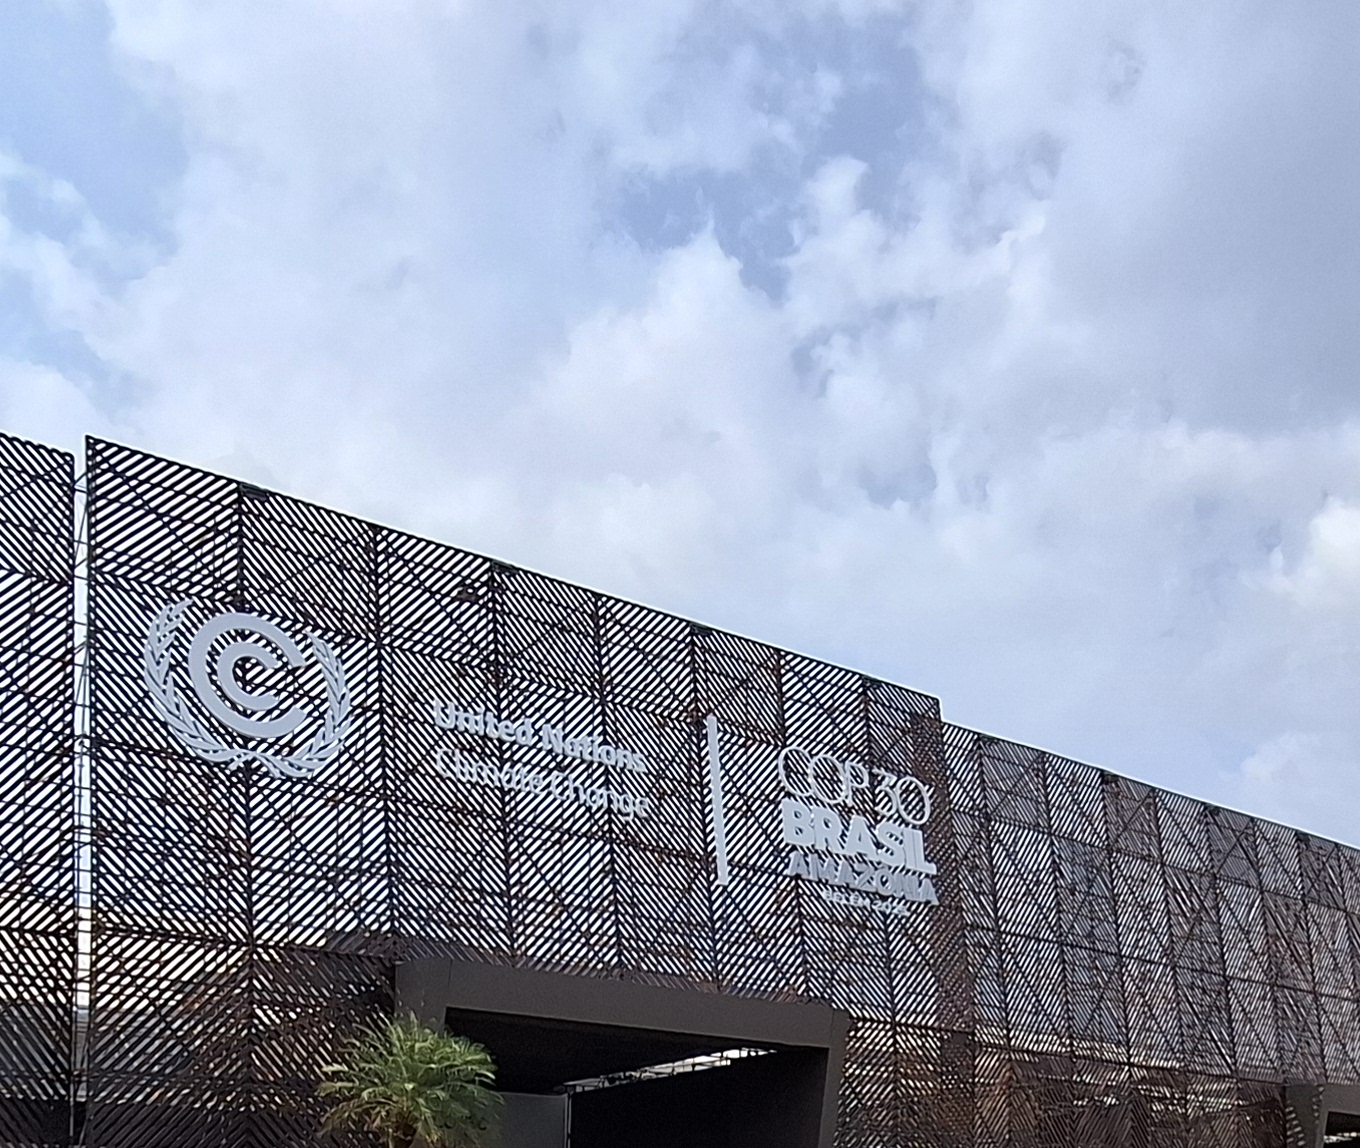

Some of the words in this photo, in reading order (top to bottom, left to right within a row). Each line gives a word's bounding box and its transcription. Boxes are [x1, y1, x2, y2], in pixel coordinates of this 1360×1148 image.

[434, 699, 534, 746] United
[541, 723, 647, 773] Nations
[436, 748, 544, 796] Climate
[550, 770, 649, 822] Change
[781, 796, 937, 875] BRASIL
